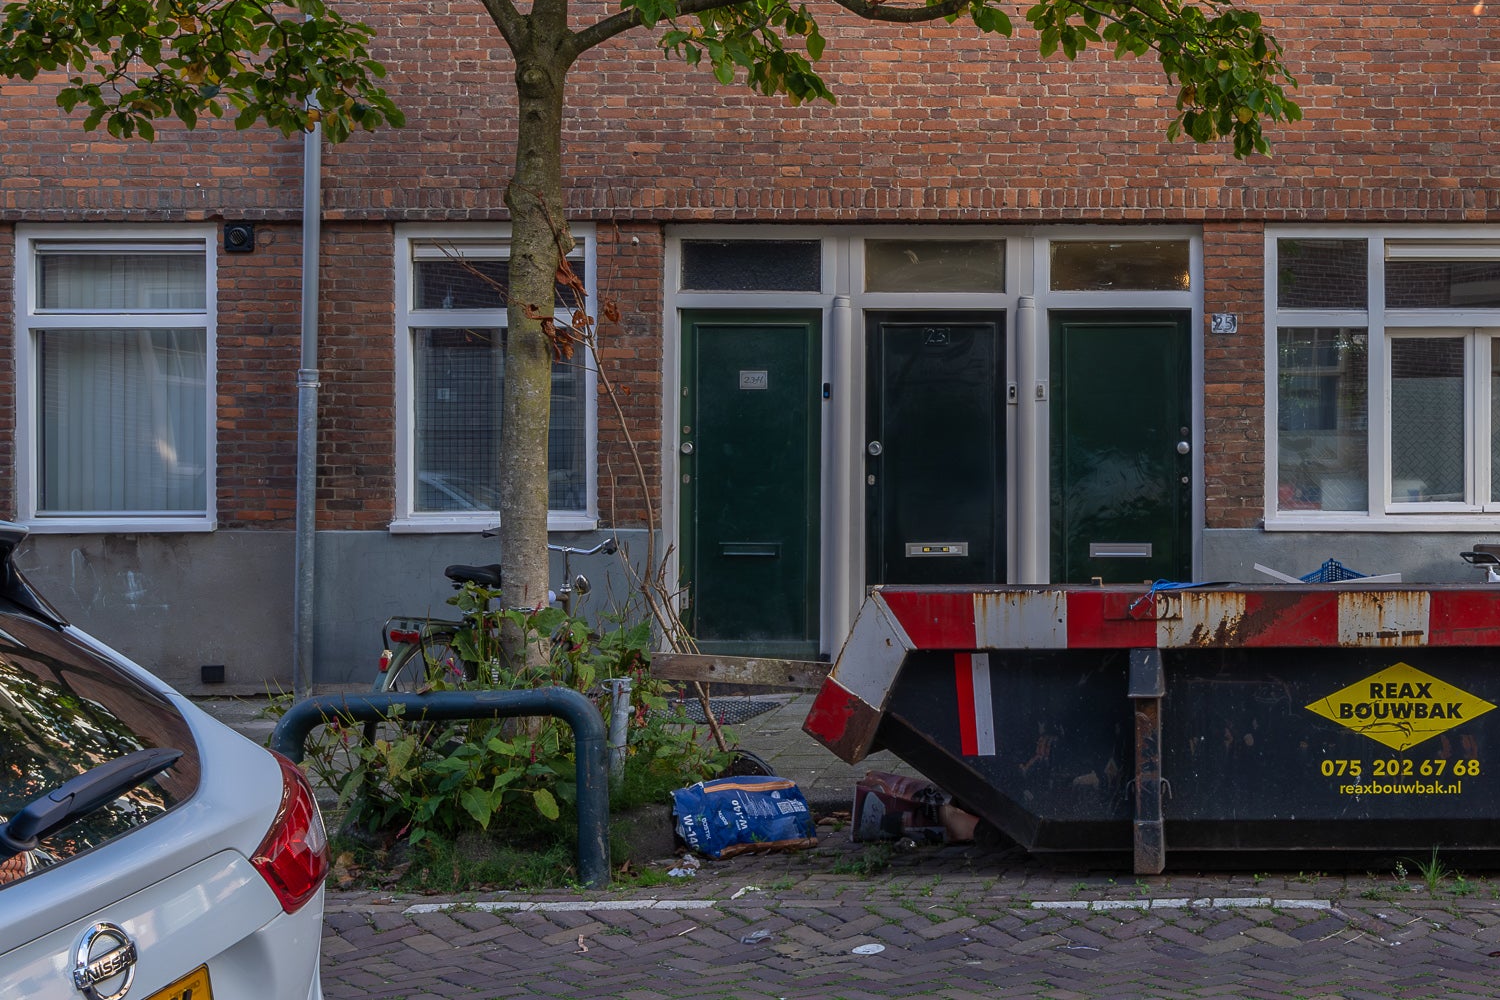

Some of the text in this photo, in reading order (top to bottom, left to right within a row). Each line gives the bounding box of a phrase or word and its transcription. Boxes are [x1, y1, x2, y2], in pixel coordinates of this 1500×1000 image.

[1215, 316, 1234, 331] 25
[1369, 682, 1433, 699] REAX
[1339, 702, 1464, 720] BOUWBAK
[1320, 759, 1481, 777] 075 202 67 68
[1339, 780, 1463, 795] reaxbouwbak.nl
